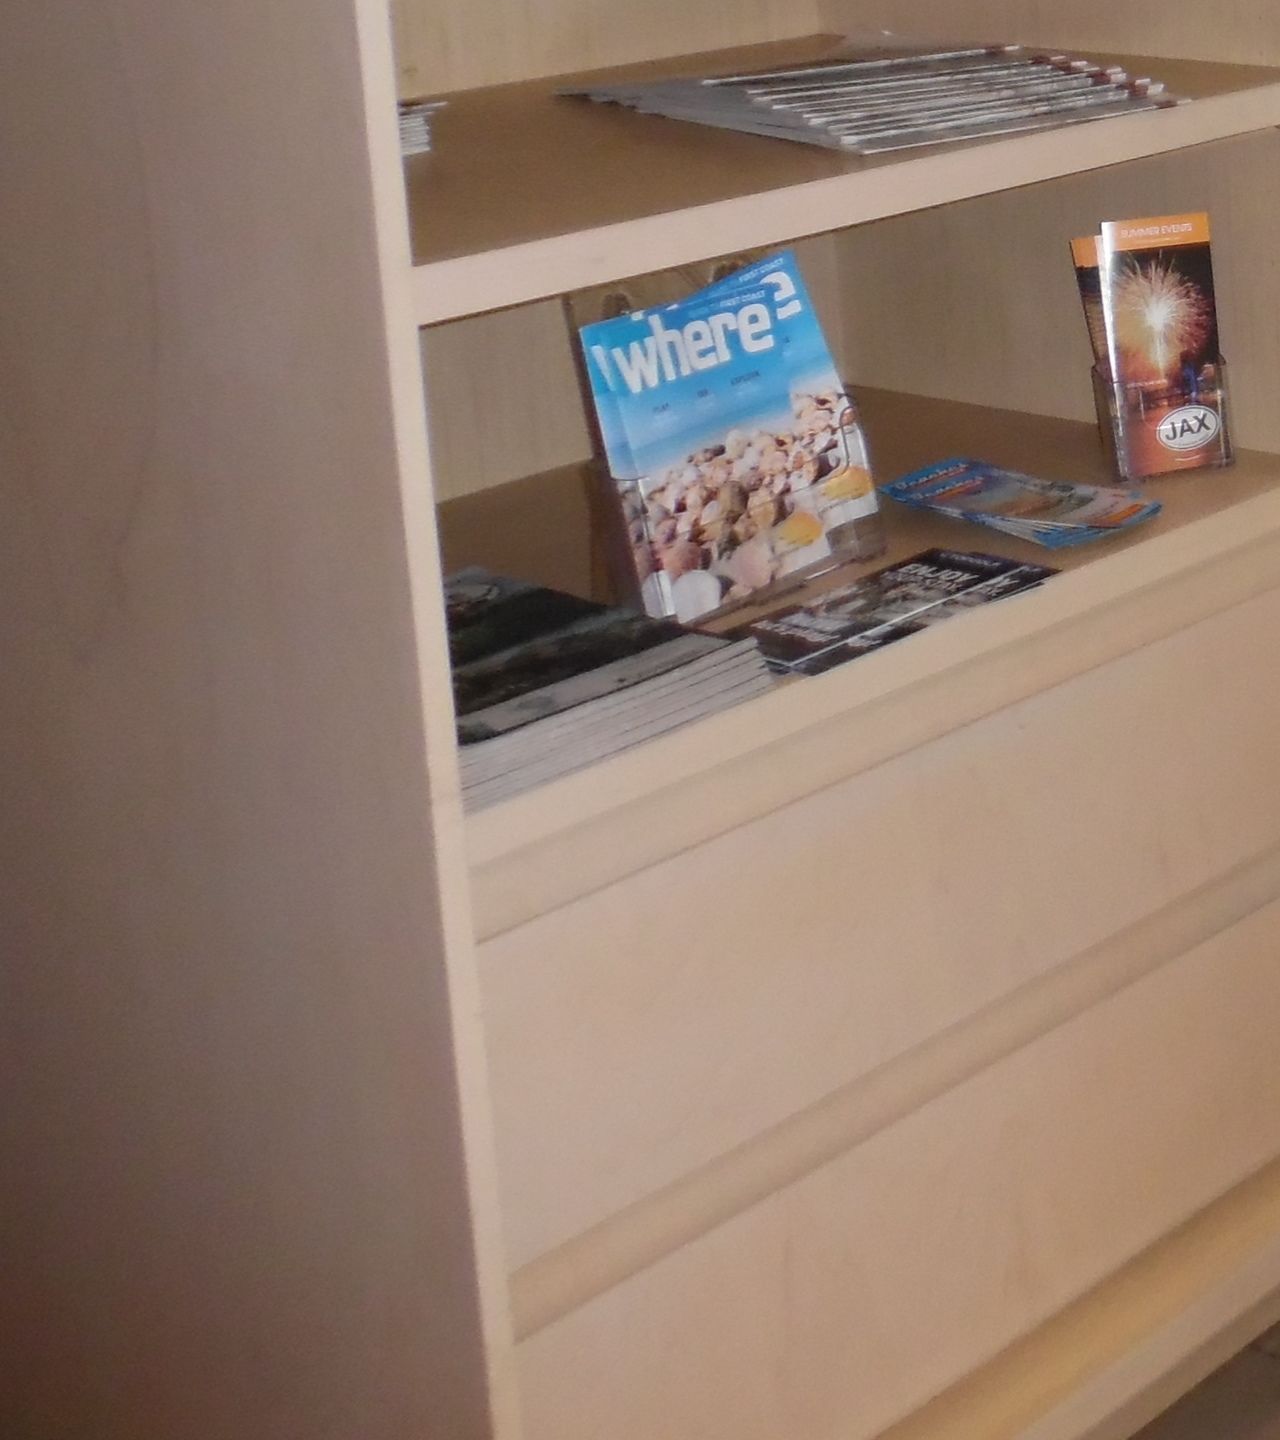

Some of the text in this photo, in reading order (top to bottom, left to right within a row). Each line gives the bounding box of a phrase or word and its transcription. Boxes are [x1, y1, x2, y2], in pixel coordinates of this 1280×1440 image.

[1119, 223, 1193, 239] SUMMER EVENTS
[1164, 412, 1211, 441] JAX
